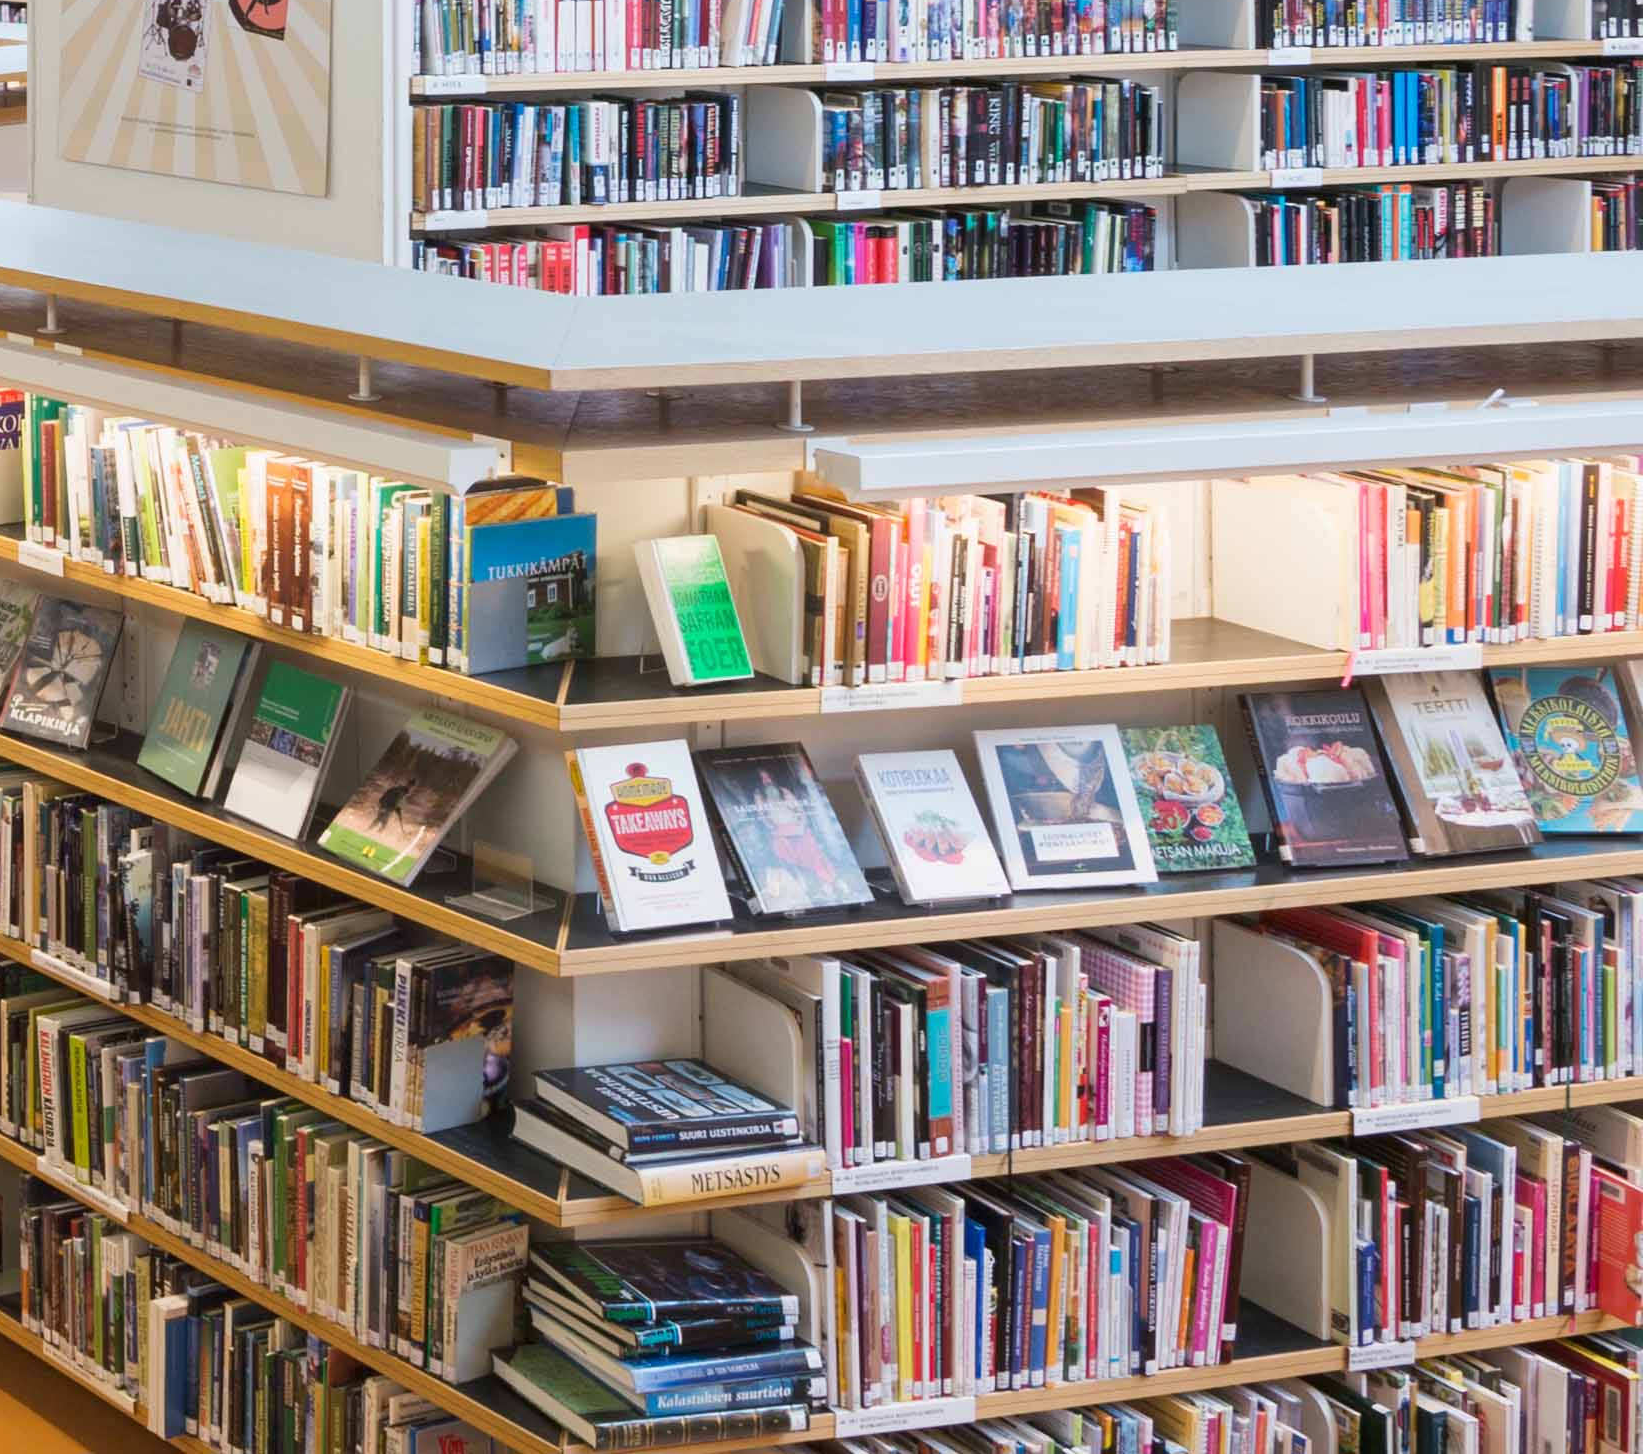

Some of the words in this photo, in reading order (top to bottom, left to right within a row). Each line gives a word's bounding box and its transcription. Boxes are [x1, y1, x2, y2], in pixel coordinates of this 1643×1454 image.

[988, 97, 1002, 135] KING
[487, 554, 588, 581] TUKKIKÄMPÄT
[679, 608, 737, 633] SAFRAN
[687, 636, 749, 672] FOER
[1412, 699, 1471, 714] TERTTI
[10, 709, 81, 736] KLAPIKIRJA
[611, 808, 688, 835] TAKEAWAYS
[43, 1096, 55, 1147] KÄSIKIRJA
[678, 1128, 707, 1141] SUURI
[709, 1125, 772, 1139] UISTINKIRJA
[691, 1163, 781, 1195] METSÄSTYS
[1565, 1153, 1580, 1276] SUKLAATA
[657, 1389, 733, 1410] Kalastuksen
[735, 1385, 792, 1403] suurtieto
